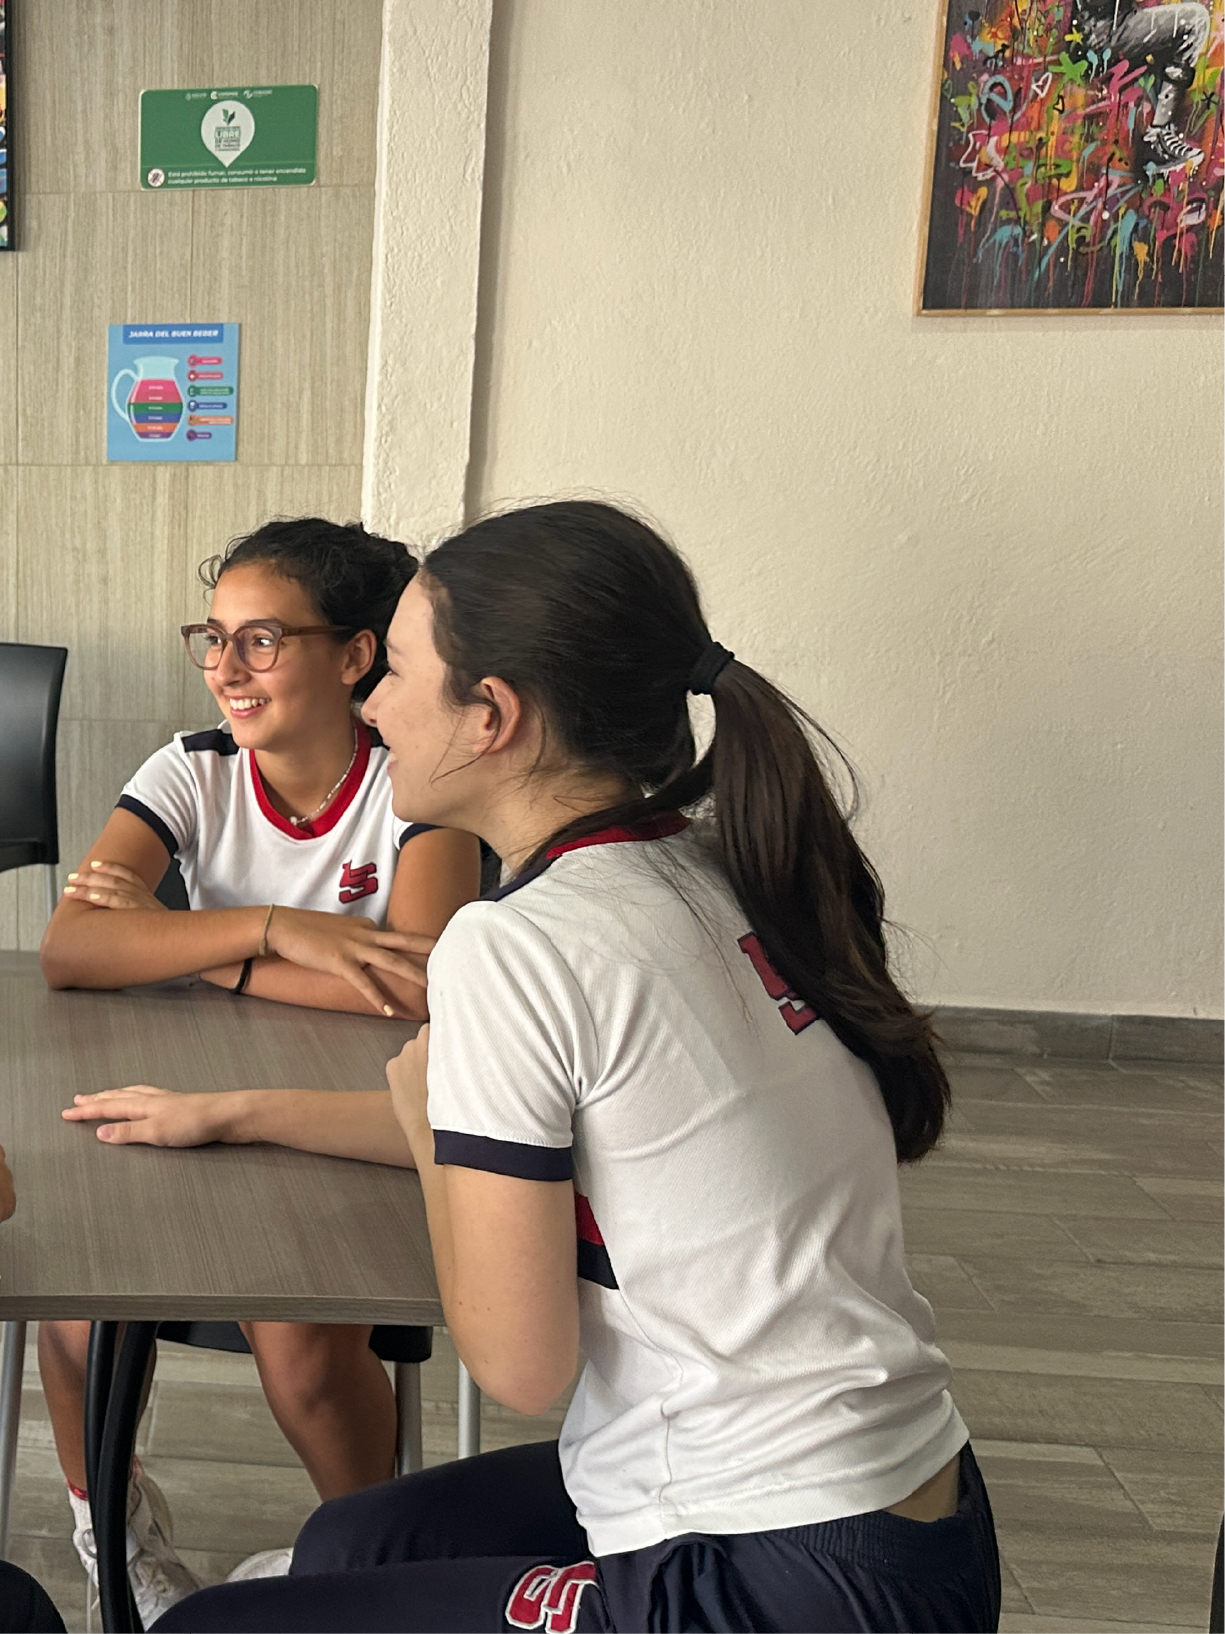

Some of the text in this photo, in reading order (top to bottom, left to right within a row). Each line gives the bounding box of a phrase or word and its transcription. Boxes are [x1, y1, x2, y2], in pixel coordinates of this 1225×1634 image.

[128, 330, 153, 338] JARRA
[155, 330, 170, 338] DEL
[171, 330, 192, 338] BUEN
